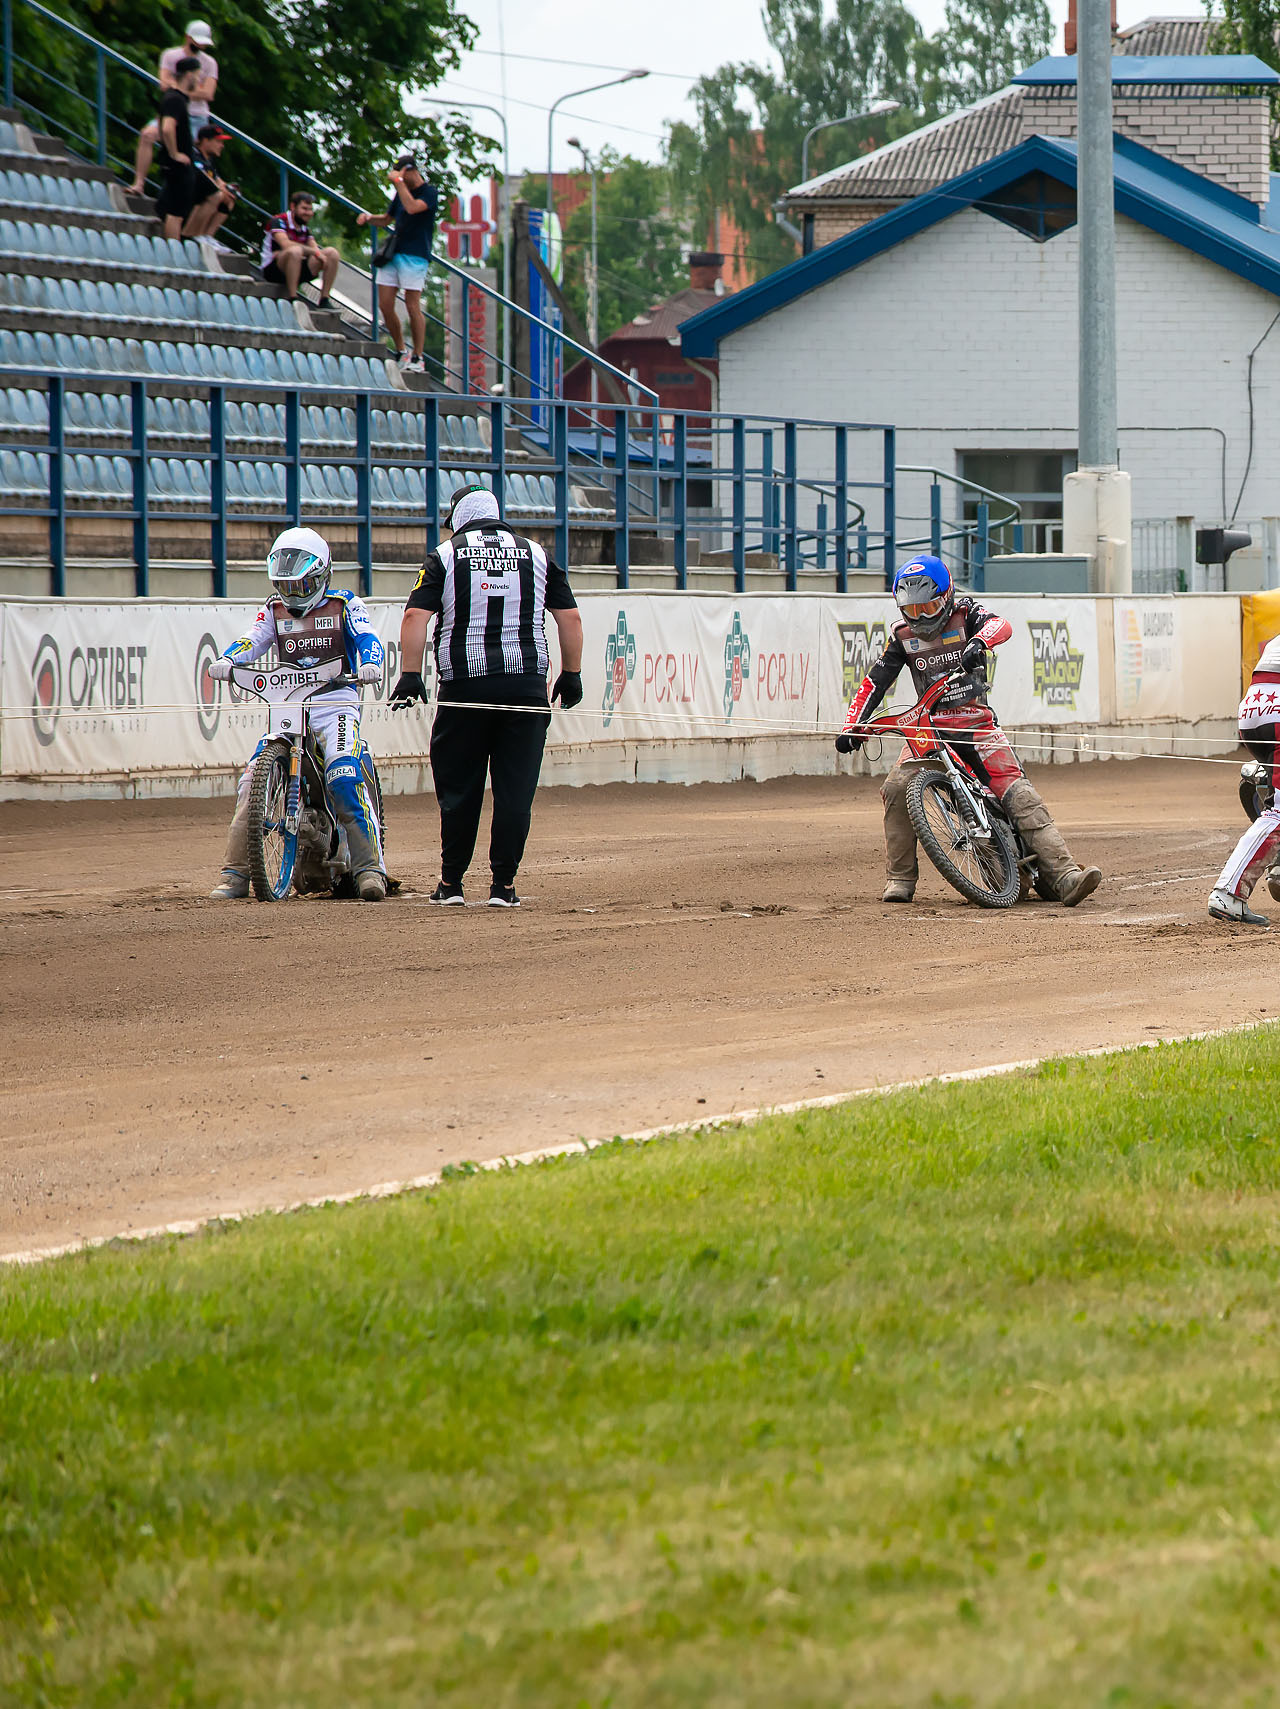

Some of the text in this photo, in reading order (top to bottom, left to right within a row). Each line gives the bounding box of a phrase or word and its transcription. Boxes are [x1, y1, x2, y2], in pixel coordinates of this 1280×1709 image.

[456, 547, 529, 560] KIEROWNIK
[470, 558, 518, 571] STARTU
[316, 618, 333, 630] MFR
[297, 637, 333, 648] OPTIBET
[928, 649, 962, 665] OPTIBET
[68, 646, 148, 712] OPTIBET
[269, 671, 319, 686] OPTIBET
[643, 652, 699, 704] PCR.LV
[228, 714, 268, 729] SPORT
